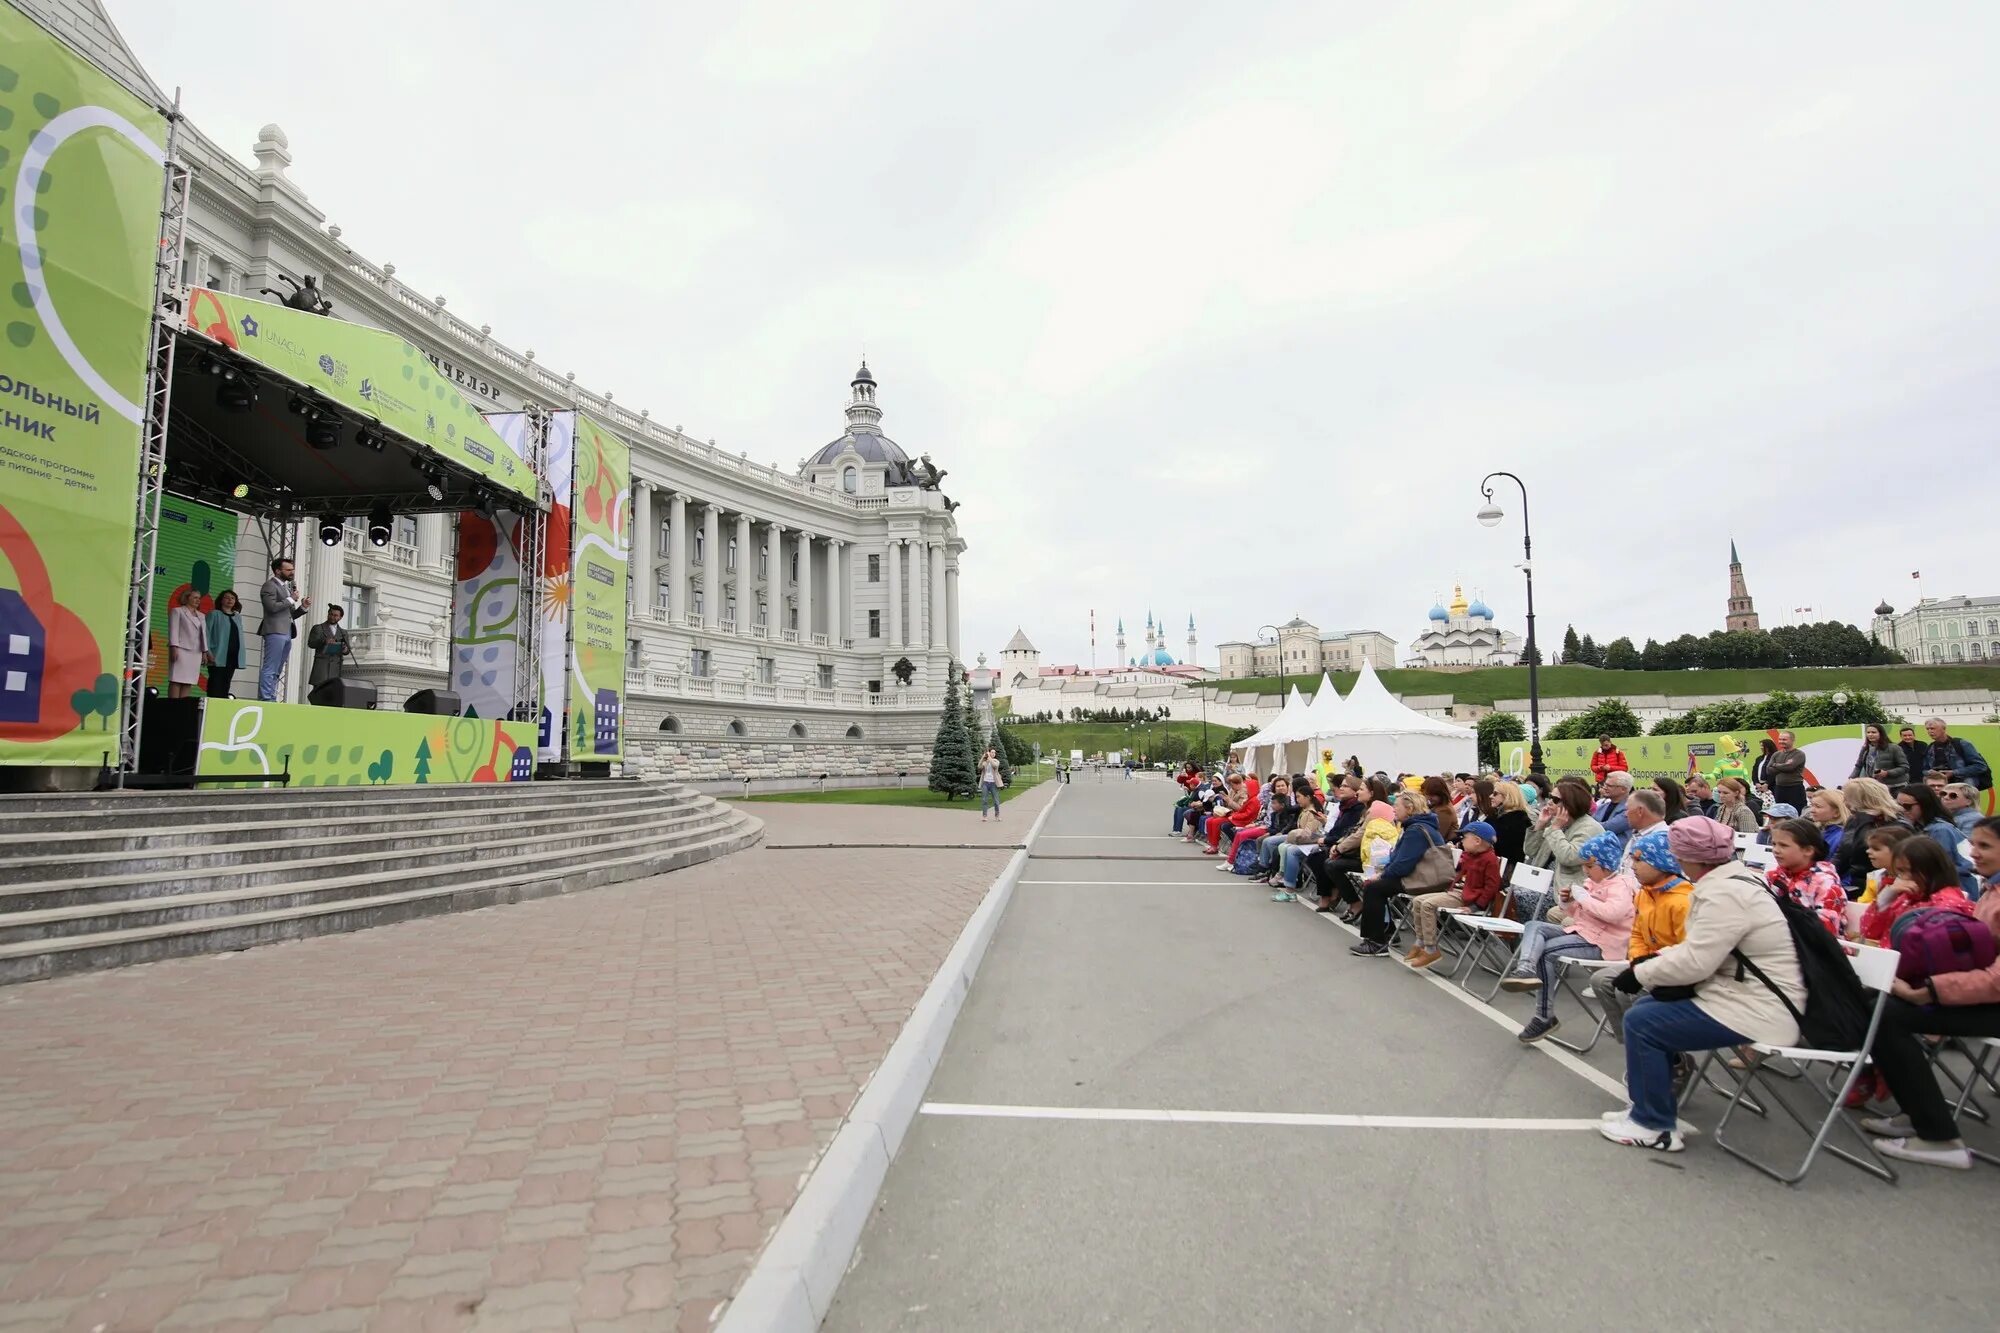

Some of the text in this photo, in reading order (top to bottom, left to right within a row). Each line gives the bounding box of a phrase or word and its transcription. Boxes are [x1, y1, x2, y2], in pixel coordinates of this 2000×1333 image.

[266, 329, 307, 359] UNACLA
[0, 408, 57, 442] ник
[8, 461, 53, 480] питание
[40, 457, 95, 480] программе
[586, 621, 613, 636] вкусное
[587, 636, 613, 651] детство
